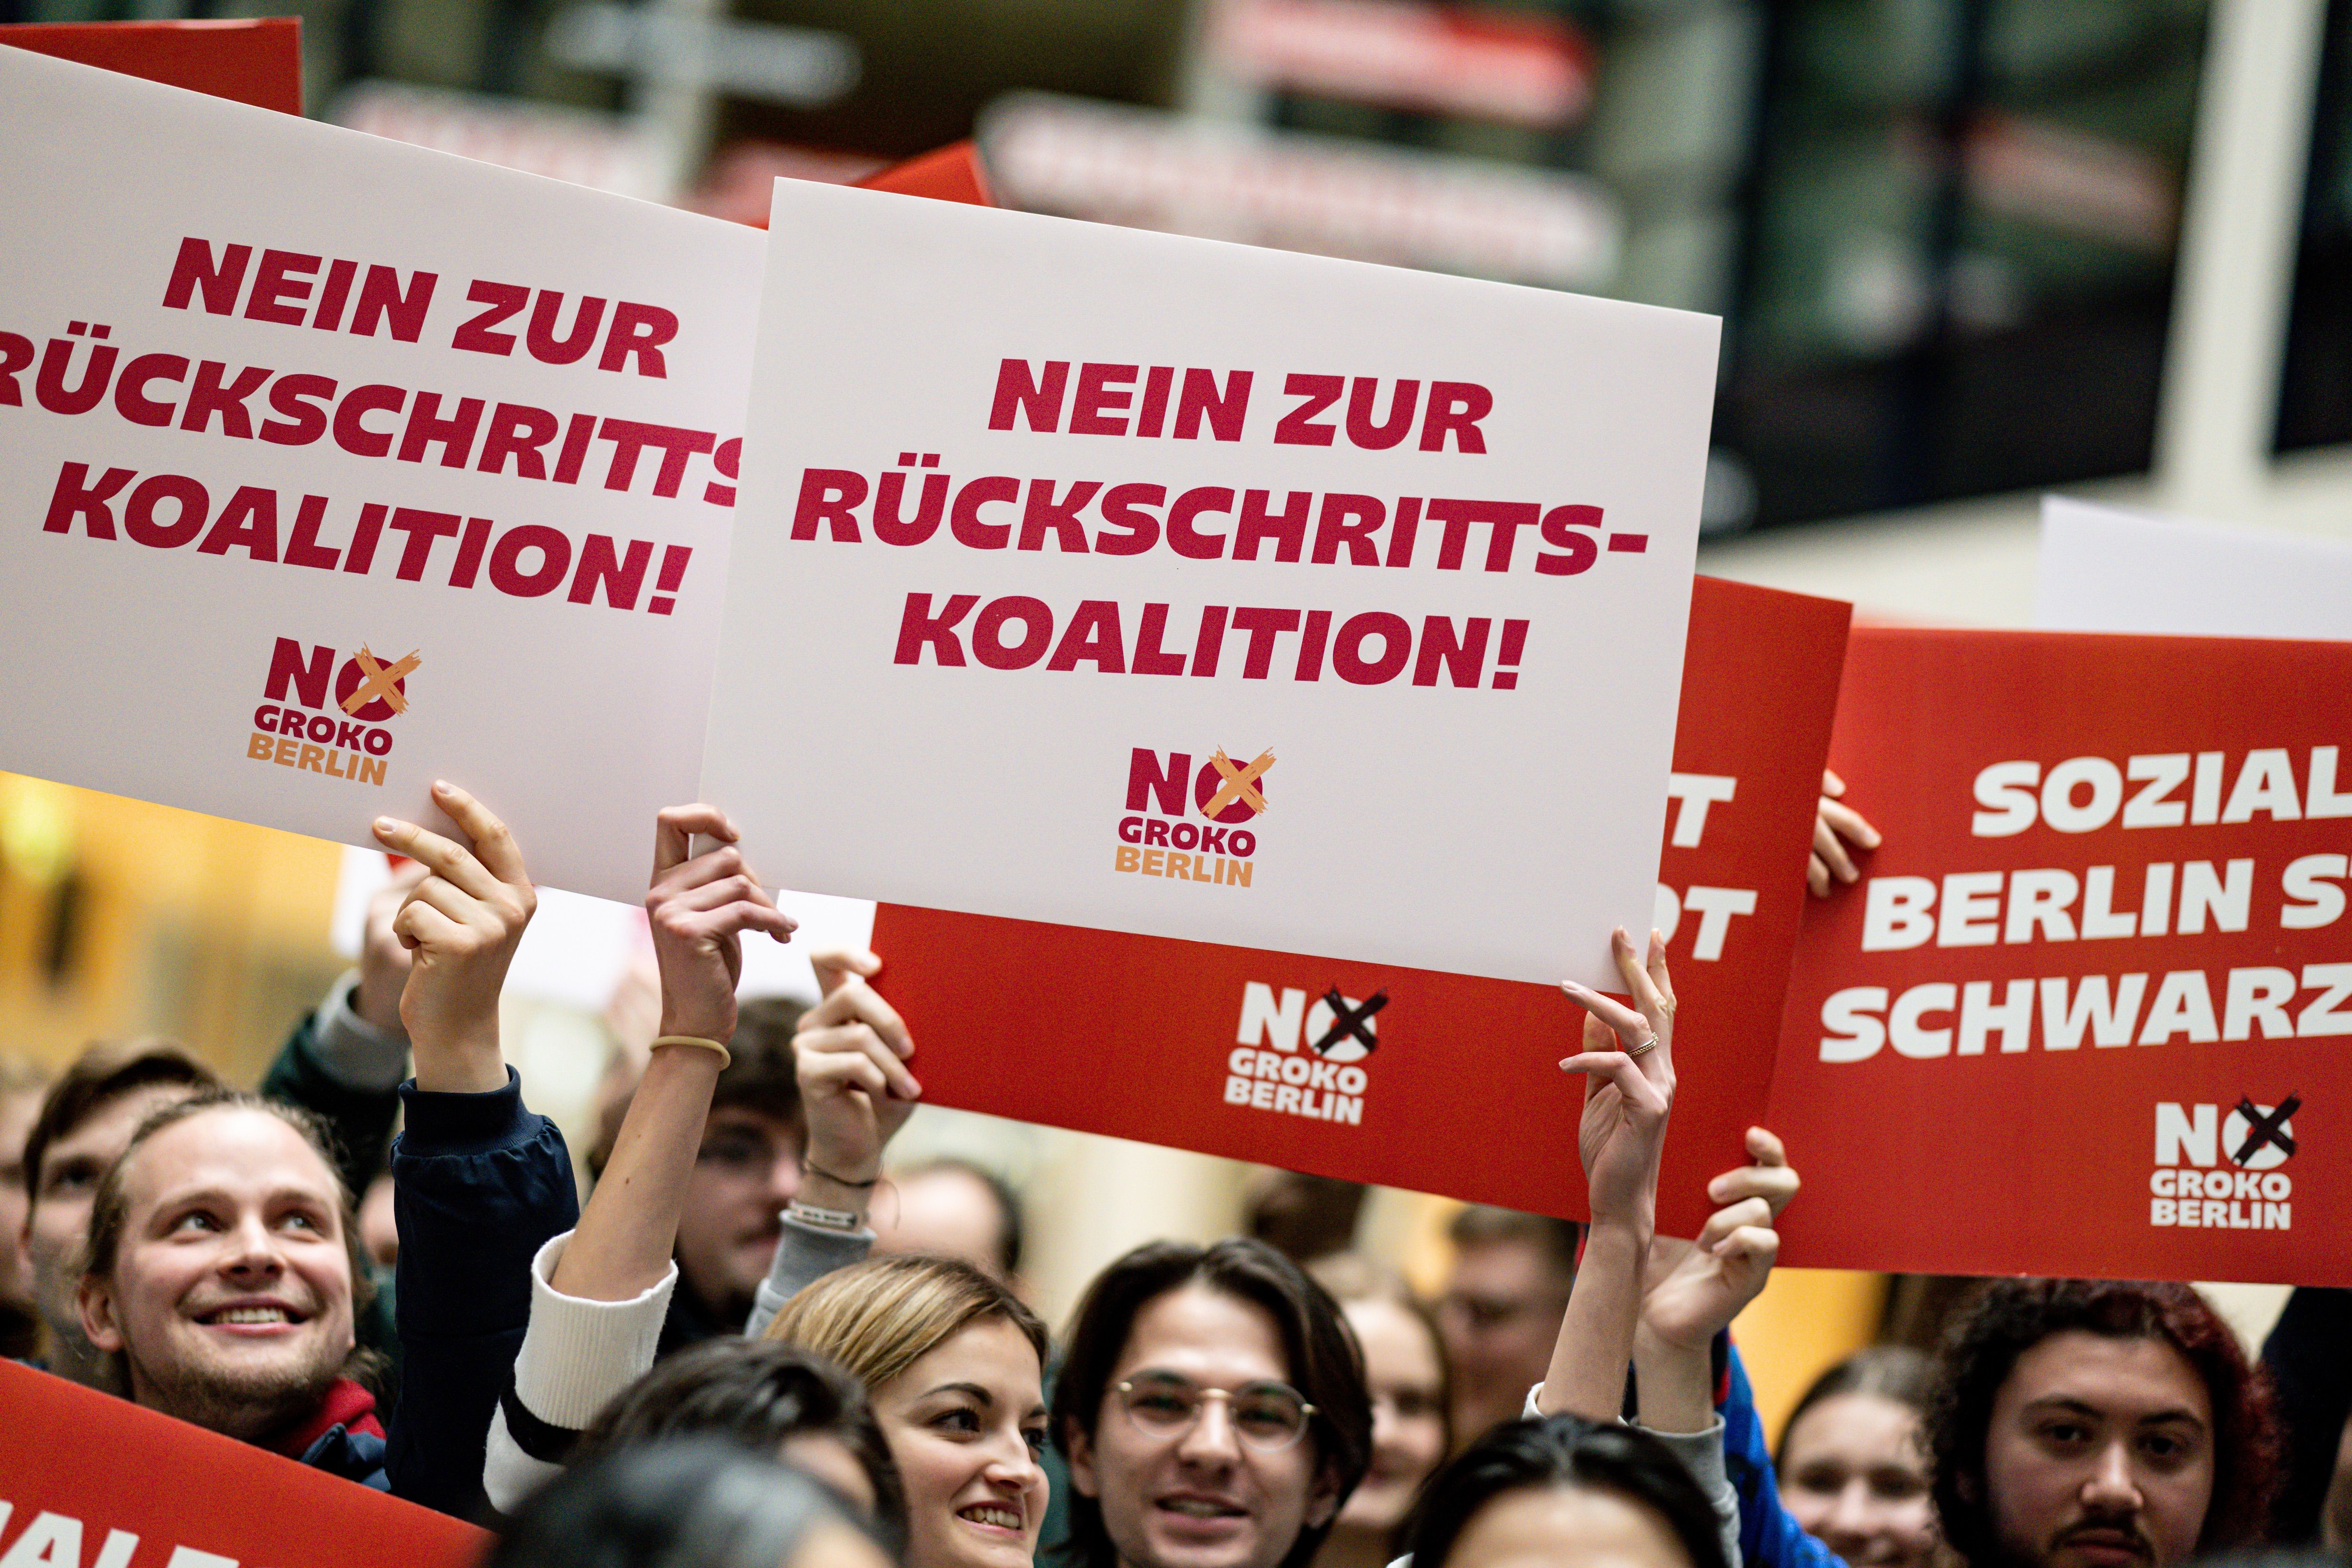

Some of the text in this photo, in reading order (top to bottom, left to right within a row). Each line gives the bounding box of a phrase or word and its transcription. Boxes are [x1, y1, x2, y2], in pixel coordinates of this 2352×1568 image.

[162, 237, 678, 379] NEIN ZUR
[988, 358, 1493, 454] NEIN ZUR
[43, 461, 692, 615] KOALITION!
[790, 452, 1648, 576] RÜCKSCHRITTS-
[264, 637, 406, 722] NO
[894, 592, 1530, 690] KOALITION!
[247, 732, 388, 786] BERLIN
[254, 705, 393, 756] GROKO
[1126, 748, 1263, 824] NO
[1971, 746, 2352, 837] SOZIAL
[1115, 845, 1253, 887] BERLIN
[1117, 816, 1257, 857] GROKO
[1861, 854, 2352, 951] BERLIN S
[1237, 981, 1377, 1062] NO
[1819, 963, 2352, 1062] SCHWARZ
[1224, 1075, 1363, 1125] BERLIN
[1228, 1047, 1368, 1095] GROKO
[2155, 1102, 2293, 1170] NO
[2150, 1169, 2292, 1201] GROKO
[2150, 1198, 2291, 1230] BERLIN
